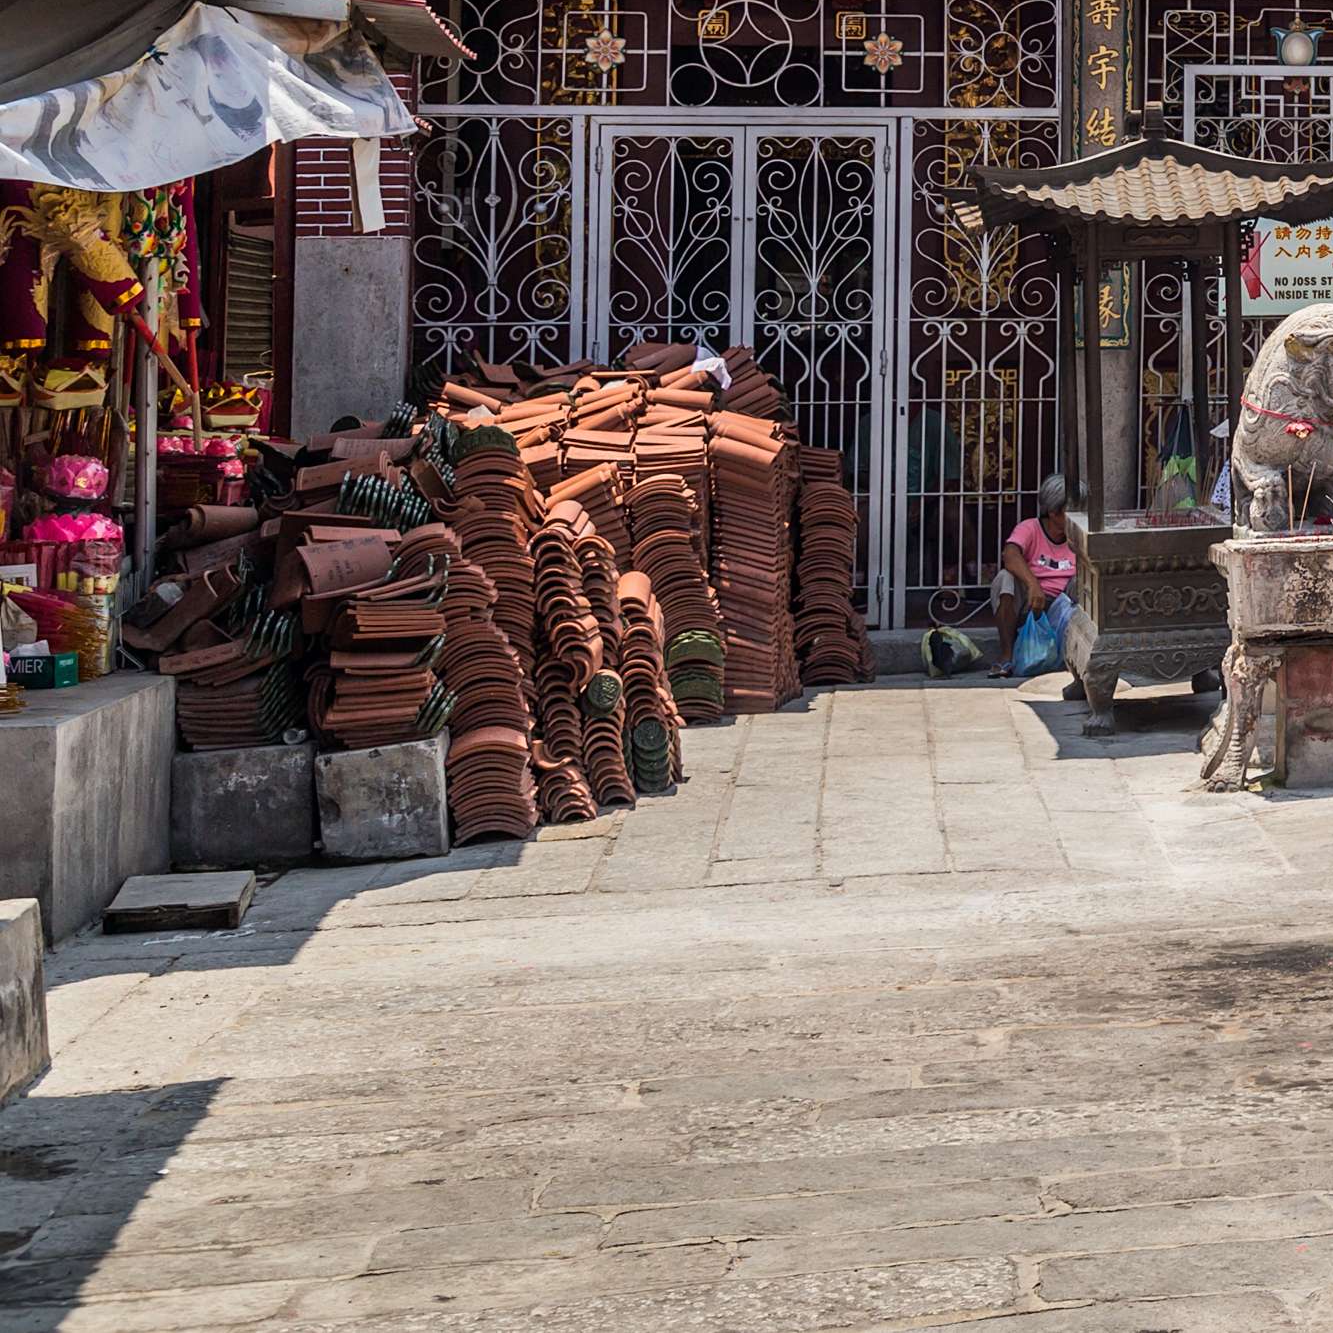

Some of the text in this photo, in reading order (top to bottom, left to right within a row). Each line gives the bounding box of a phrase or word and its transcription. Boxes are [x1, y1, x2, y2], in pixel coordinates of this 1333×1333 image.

[1274, 277, 1288, 286] NO
[1292, 277, 1317, 286] JOSS
[1274, 290, 1309, 300] INSIDE
[1312, 290, 1331, 299] THE
[7, 659, 43, 674] MIER
